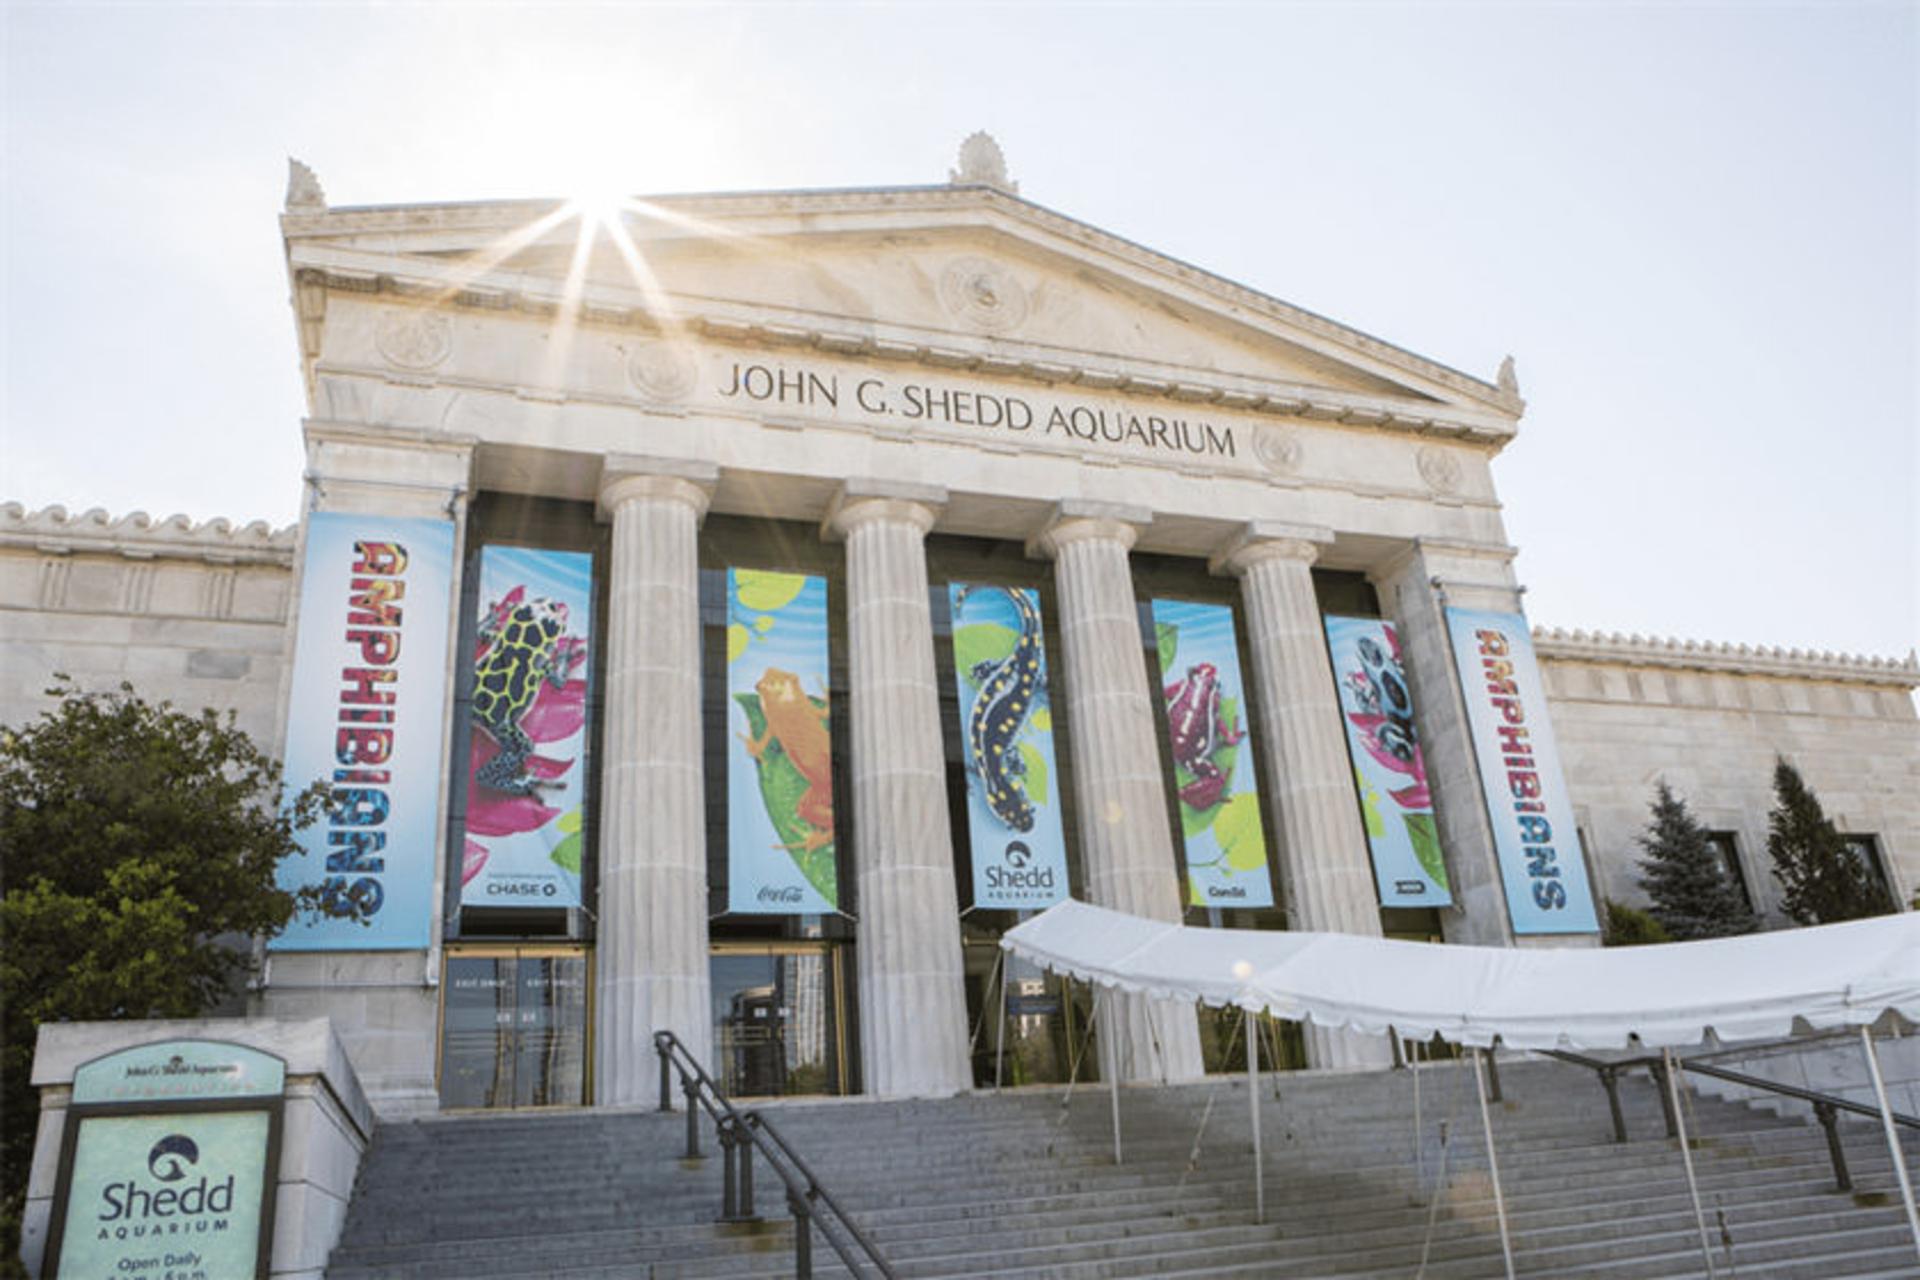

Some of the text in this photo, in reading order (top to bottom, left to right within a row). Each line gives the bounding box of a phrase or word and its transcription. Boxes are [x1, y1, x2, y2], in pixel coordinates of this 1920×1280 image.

[719, 364, 1237, 458] JOHN G. SHEDD AQUARIUM
[322, 540, 408, 920] AMPHIBIANS
[1475, 629, 1567, 911] AMPHIBIANS
[487, 883, 541, 896] CHASE
[985, 864, 1054, 888] Shedd
[98, 1175, 234, 1221] Shedd
[97, 1219, 229, 1240] AQUARIUM
[118, 1250, 203, 1273] Open Daily
